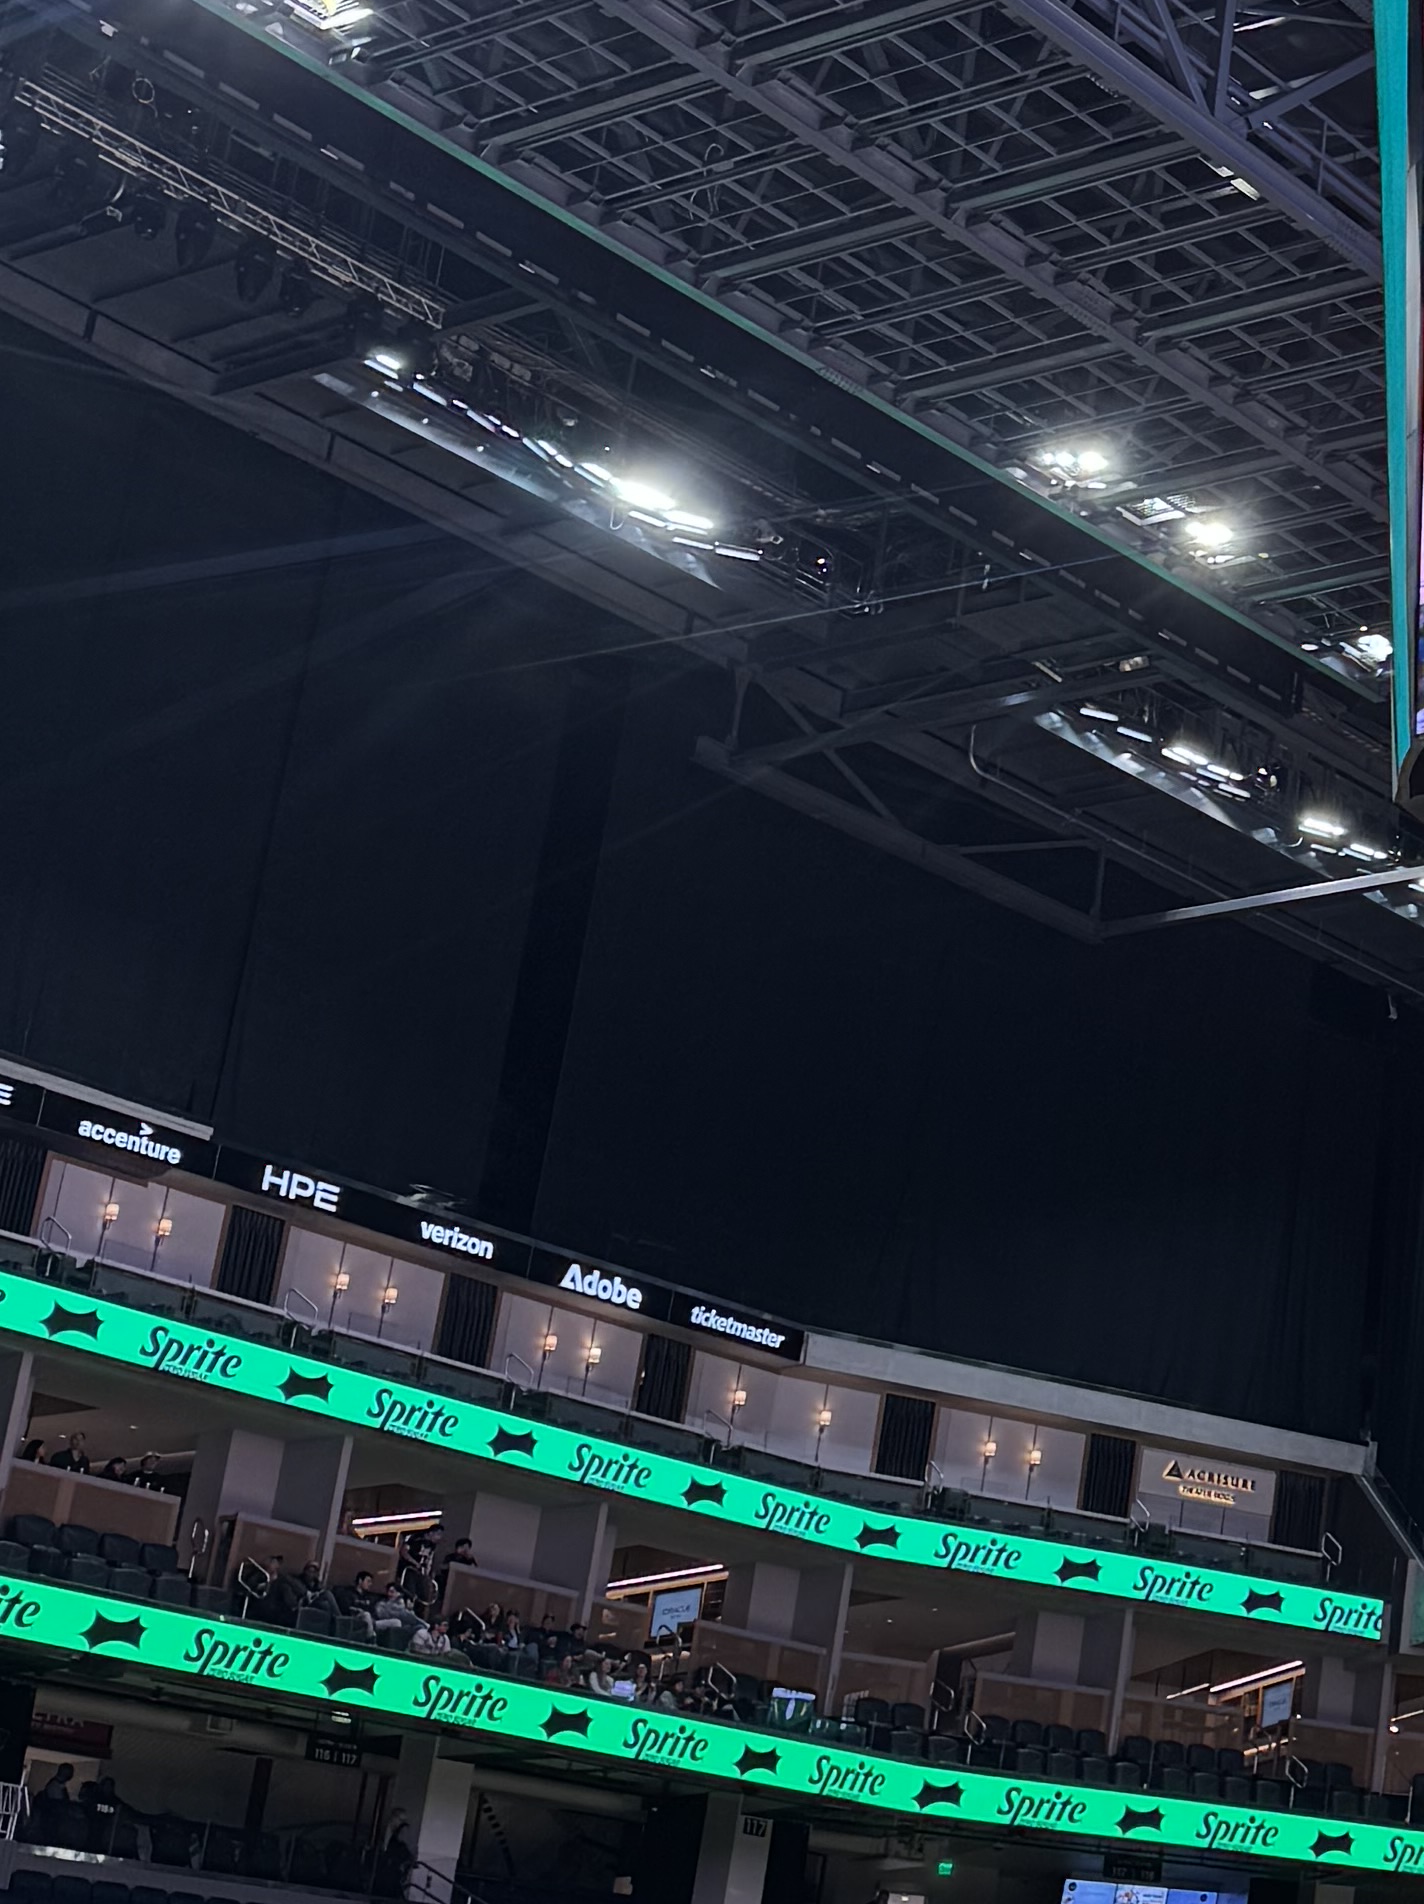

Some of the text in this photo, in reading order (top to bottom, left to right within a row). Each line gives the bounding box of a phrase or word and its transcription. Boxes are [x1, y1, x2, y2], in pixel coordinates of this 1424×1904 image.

[79, 1117, 181, 1165] accenture
[261, 1165, 341, 1213] HPE
[420, 1219, 494, 1261] verizon
[559, 1263, 642, 1310] Adobe
[690, 1305, 785, 1349] ticketmaster
[139, 1326, 243, 1377] Sprite
[366, 1388, 459, 1435] Sprite
[568, 1443, 652, 1487] Sprite
[1187, 1469, 1256, 1491] ACRISURE
[755, 1492, 831, 1533] Sprite
[934, 1533, 1021, 1569] Sprite
[1133, 1566, 1214, 1602] Sprite
[183, 1628, 290, 1678] Sprite
[412, 1674, 508, 1723] Sprite
[622, 1718, 708, 1764] Sprite
[807, 1754, 885, 1799] Sprite
